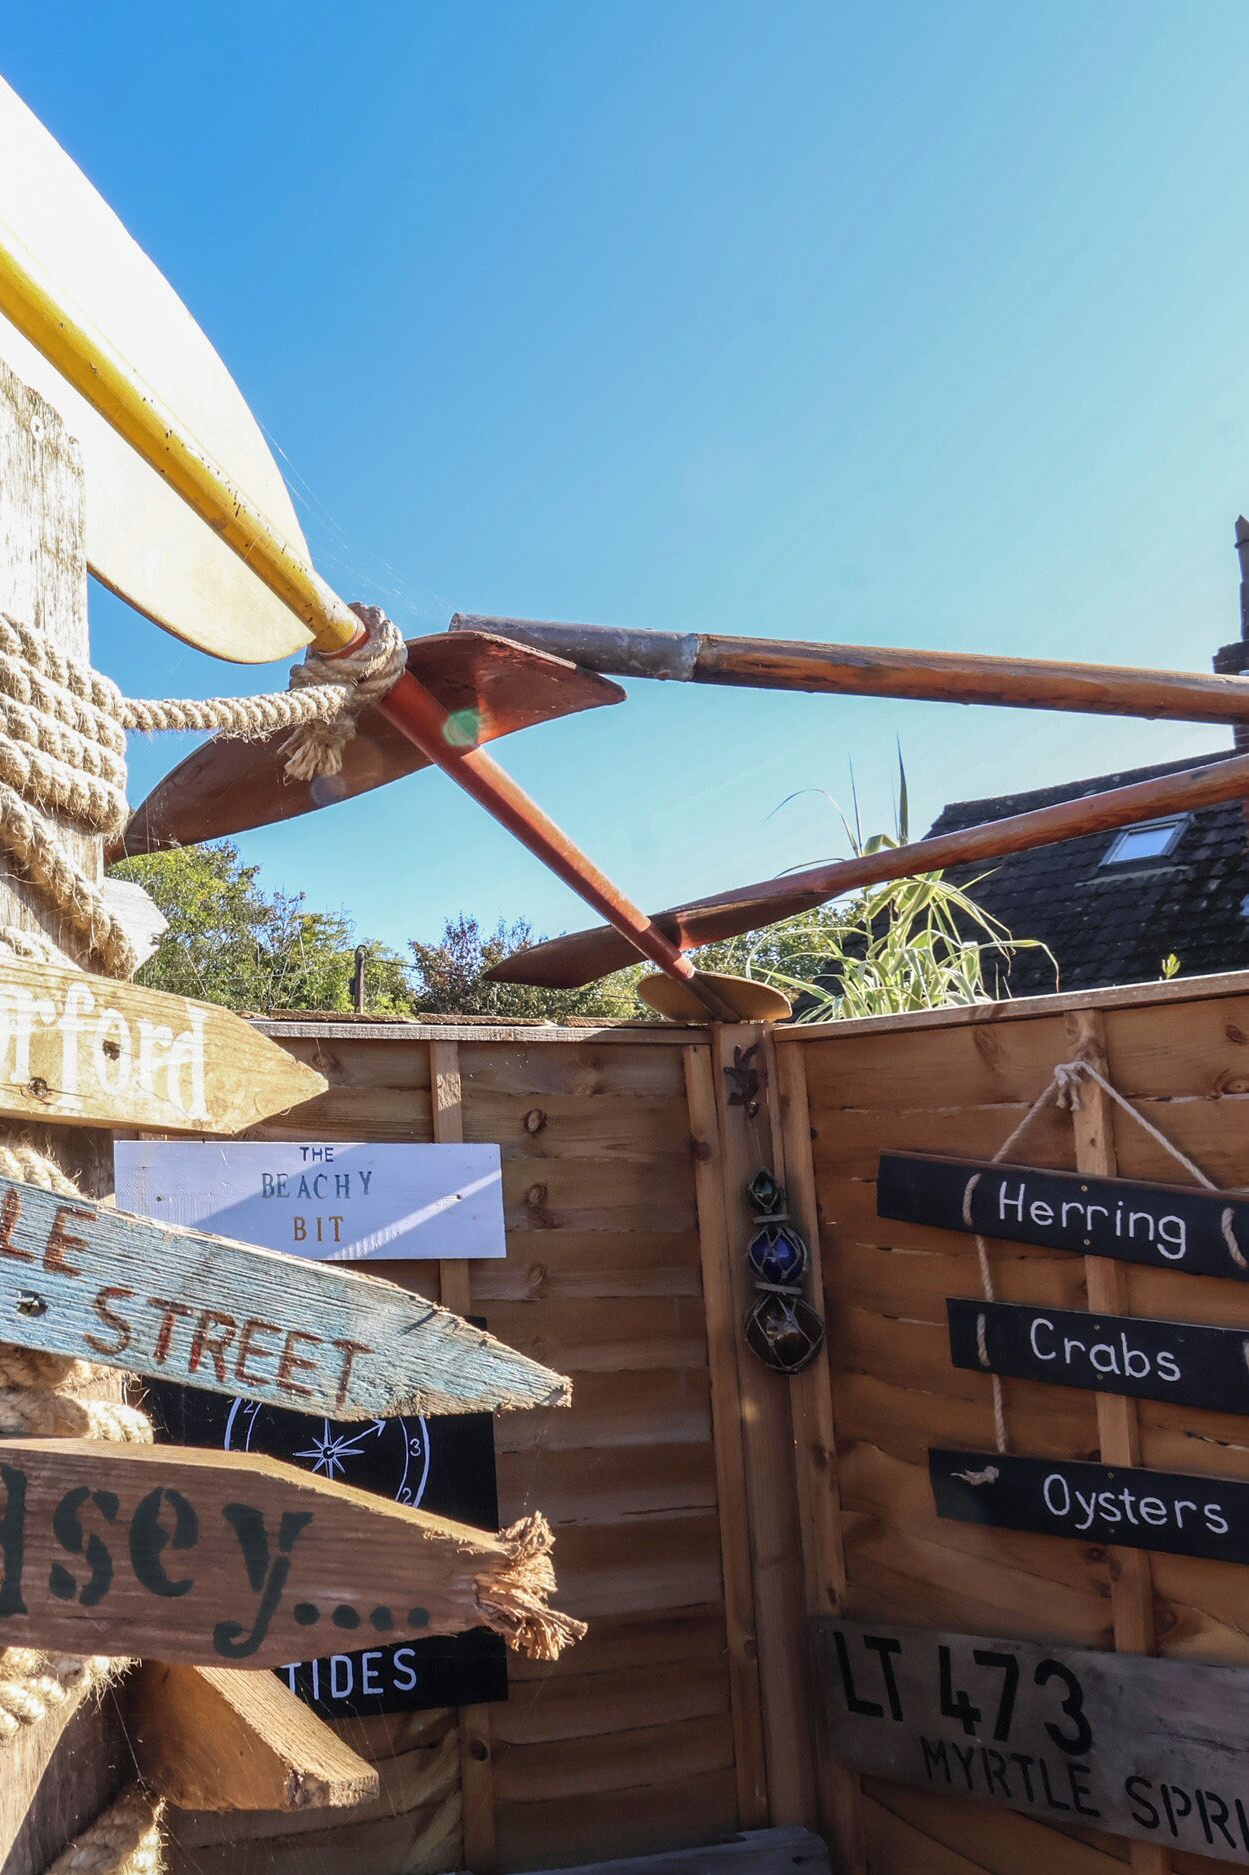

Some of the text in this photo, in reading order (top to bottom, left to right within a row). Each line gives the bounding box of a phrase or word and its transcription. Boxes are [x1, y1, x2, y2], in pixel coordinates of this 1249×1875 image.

[300, 1147, 334, 1162] THE
[261, 1171, 372, 1199] BEACHY
[293, 1216, 344, 1242] BIT
[999, 1182, 1187, 1260] Herring
[84, 1286, 373, 1405] STREET
[1030, 1318, 1181, 1381] Crabs
[409, 1438, 421, 1457] 3
[402, 1488, 413, 1506] 2
[1043, 1473, 1229, 1535] Oysters
[280, 1648, 417, 1700] TIDES
[833, 1631, 1093, 1757] LT 473
[920, 1735, 1249, 1852] MYRTLE SPRI
